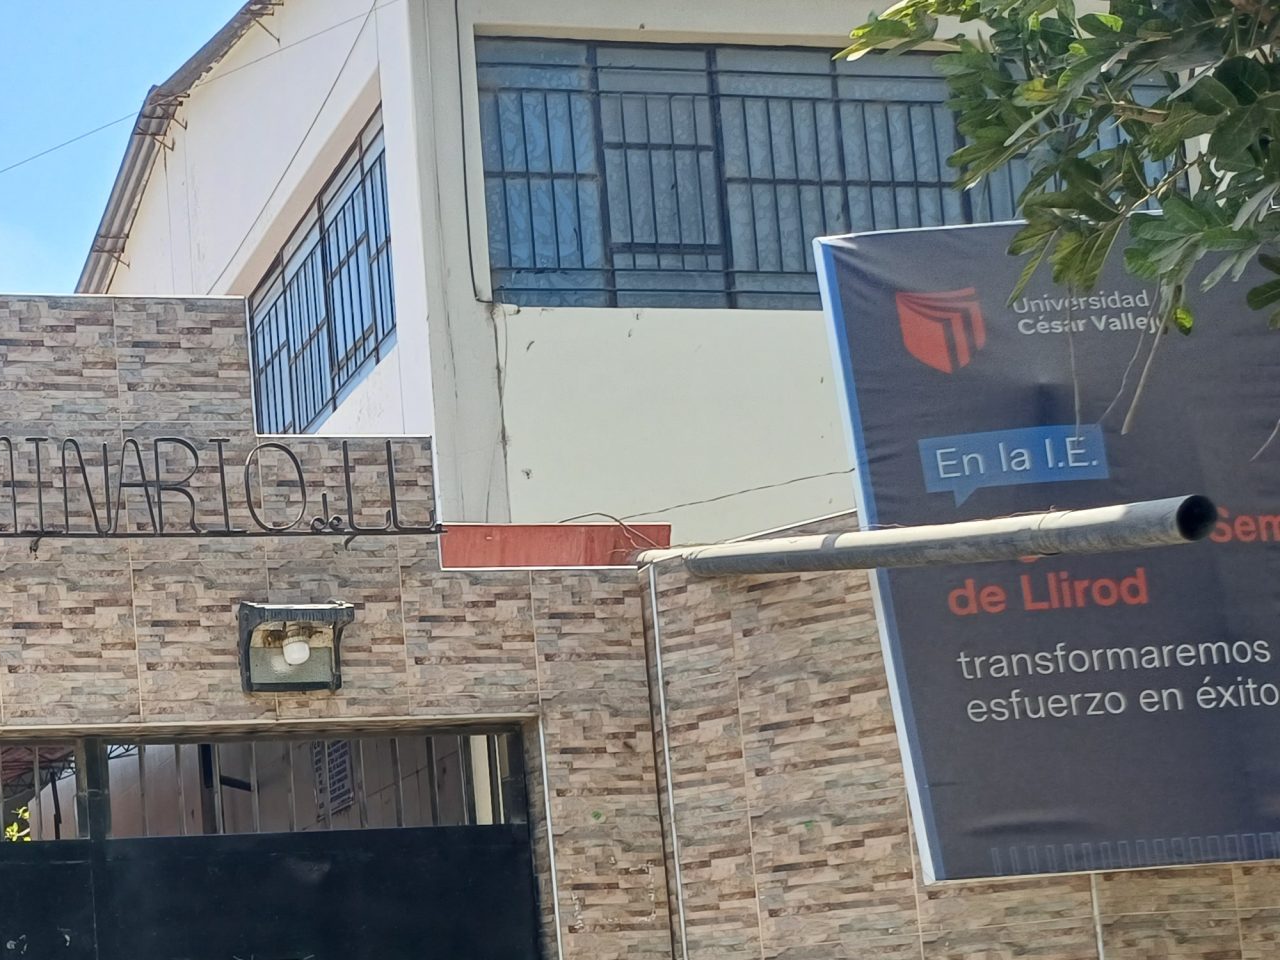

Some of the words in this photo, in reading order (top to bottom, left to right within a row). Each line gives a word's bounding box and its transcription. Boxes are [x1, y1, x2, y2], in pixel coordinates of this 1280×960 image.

[1012, 289, 1150, 313] Universidad
[1017, 315, 1087, 335] César
[935, 447, 985, 480] En
[998, 441, 1031, 472] la
[1045, 436, 1099, 469] I.E.
[947, 578, 1007, 616] de
[1020, 567, 1150, 612] Llirod
[956, 638, 1272, 680] transformaremos
[966, 687, 1127, 723] esfuerzo
[1138, 686, 1184, 713] en
[1196, 676, 1279, 709] éxito
